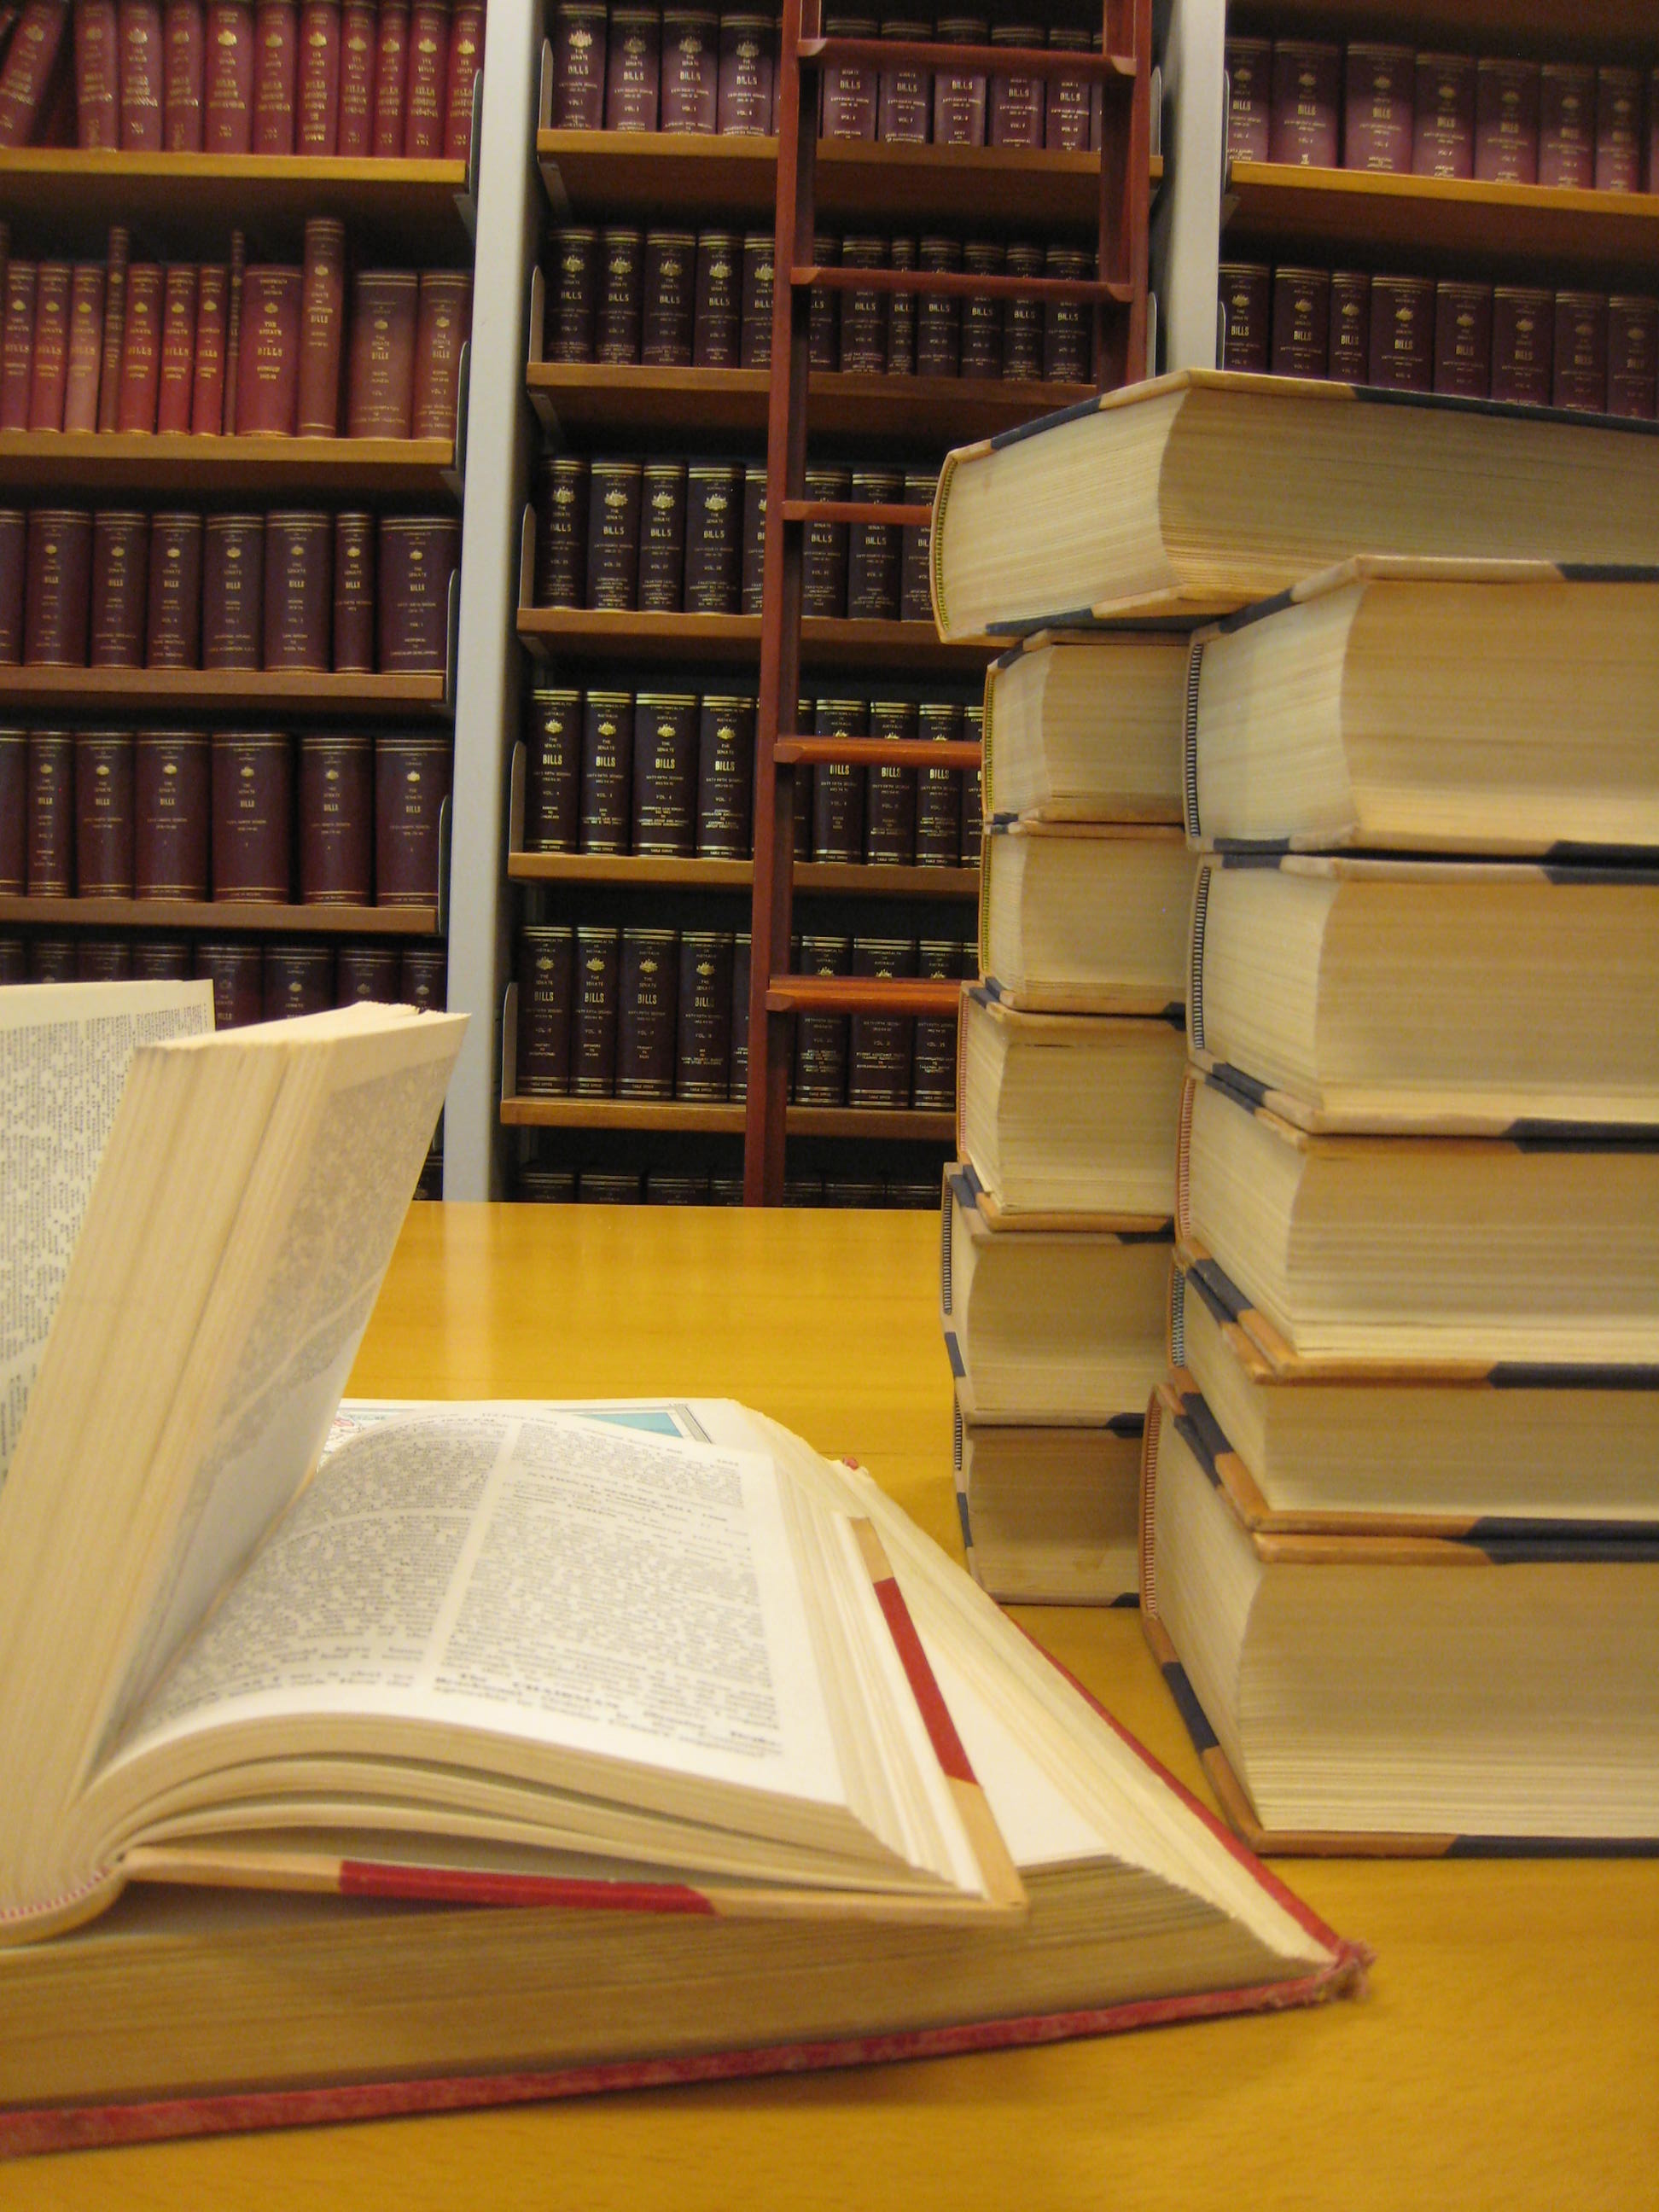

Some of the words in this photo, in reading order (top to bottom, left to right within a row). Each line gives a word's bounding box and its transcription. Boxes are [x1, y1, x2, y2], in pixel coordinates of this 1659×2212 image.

[568, 66, 588, 74] BILLS
[624, 72, 643, 80] BILLS
[680, 71, 700, 80] BILLS
[736, 76, 757, 84] BILLS
[841, 80, 860, 90] BILLS
[897, 83, 917, 92] BILLS
[952, 80, 972, 90] BILLS
[416, 87, 434, 96] BILLS
[1009, 89, 1029, 97] BILLS
[1060, 93, 1080, 102] BILLS
[1233, 101, 1250, 110] BILLS
[1298, 105, 1316, 115] BILLS
[1373, 108, 1391, 119] BILLS
[660, 295, 680, 304] BILLS
[972, 307, 992, 316] BILLS
[1058, 312, 1078, 321] BILLS
[1231, 326, 1249, 335] BILLS
[1294, 331, 1311, 341] BILLS
[1342, 335, 1358, 345] BILLS
[5, 344, 29, 353] BILLS
[1395, 340, 1412, 349] BILLS
[38, 346, 61, 355] BILLS
[258, 347, 282, 356] BILLS
[433, 350, 450, 358] BILLS
[1456, 345, 1473, 355] BILLS
[1515, 350, 1533, 360] BILLS
[651, 528, 672, 537] BILLS
[543, 754, 562, 765] BILLS
[596, 756, 615, 767] BILLS
[655, 759, 675, 768] BILLS
[715, 761, 734, 771] BILLS
[830, 765, 849, 775] BILLS
[882, 767, 900, 777] BILLS
[930, 770, 948, 778] BILLS
[535, 992, 553, 1001] BILLS
[585, 992, 604, 1003] BILLS
[637, 994, 656, 1004] BILLS
[696, 997, 713, 1007] BILLS
